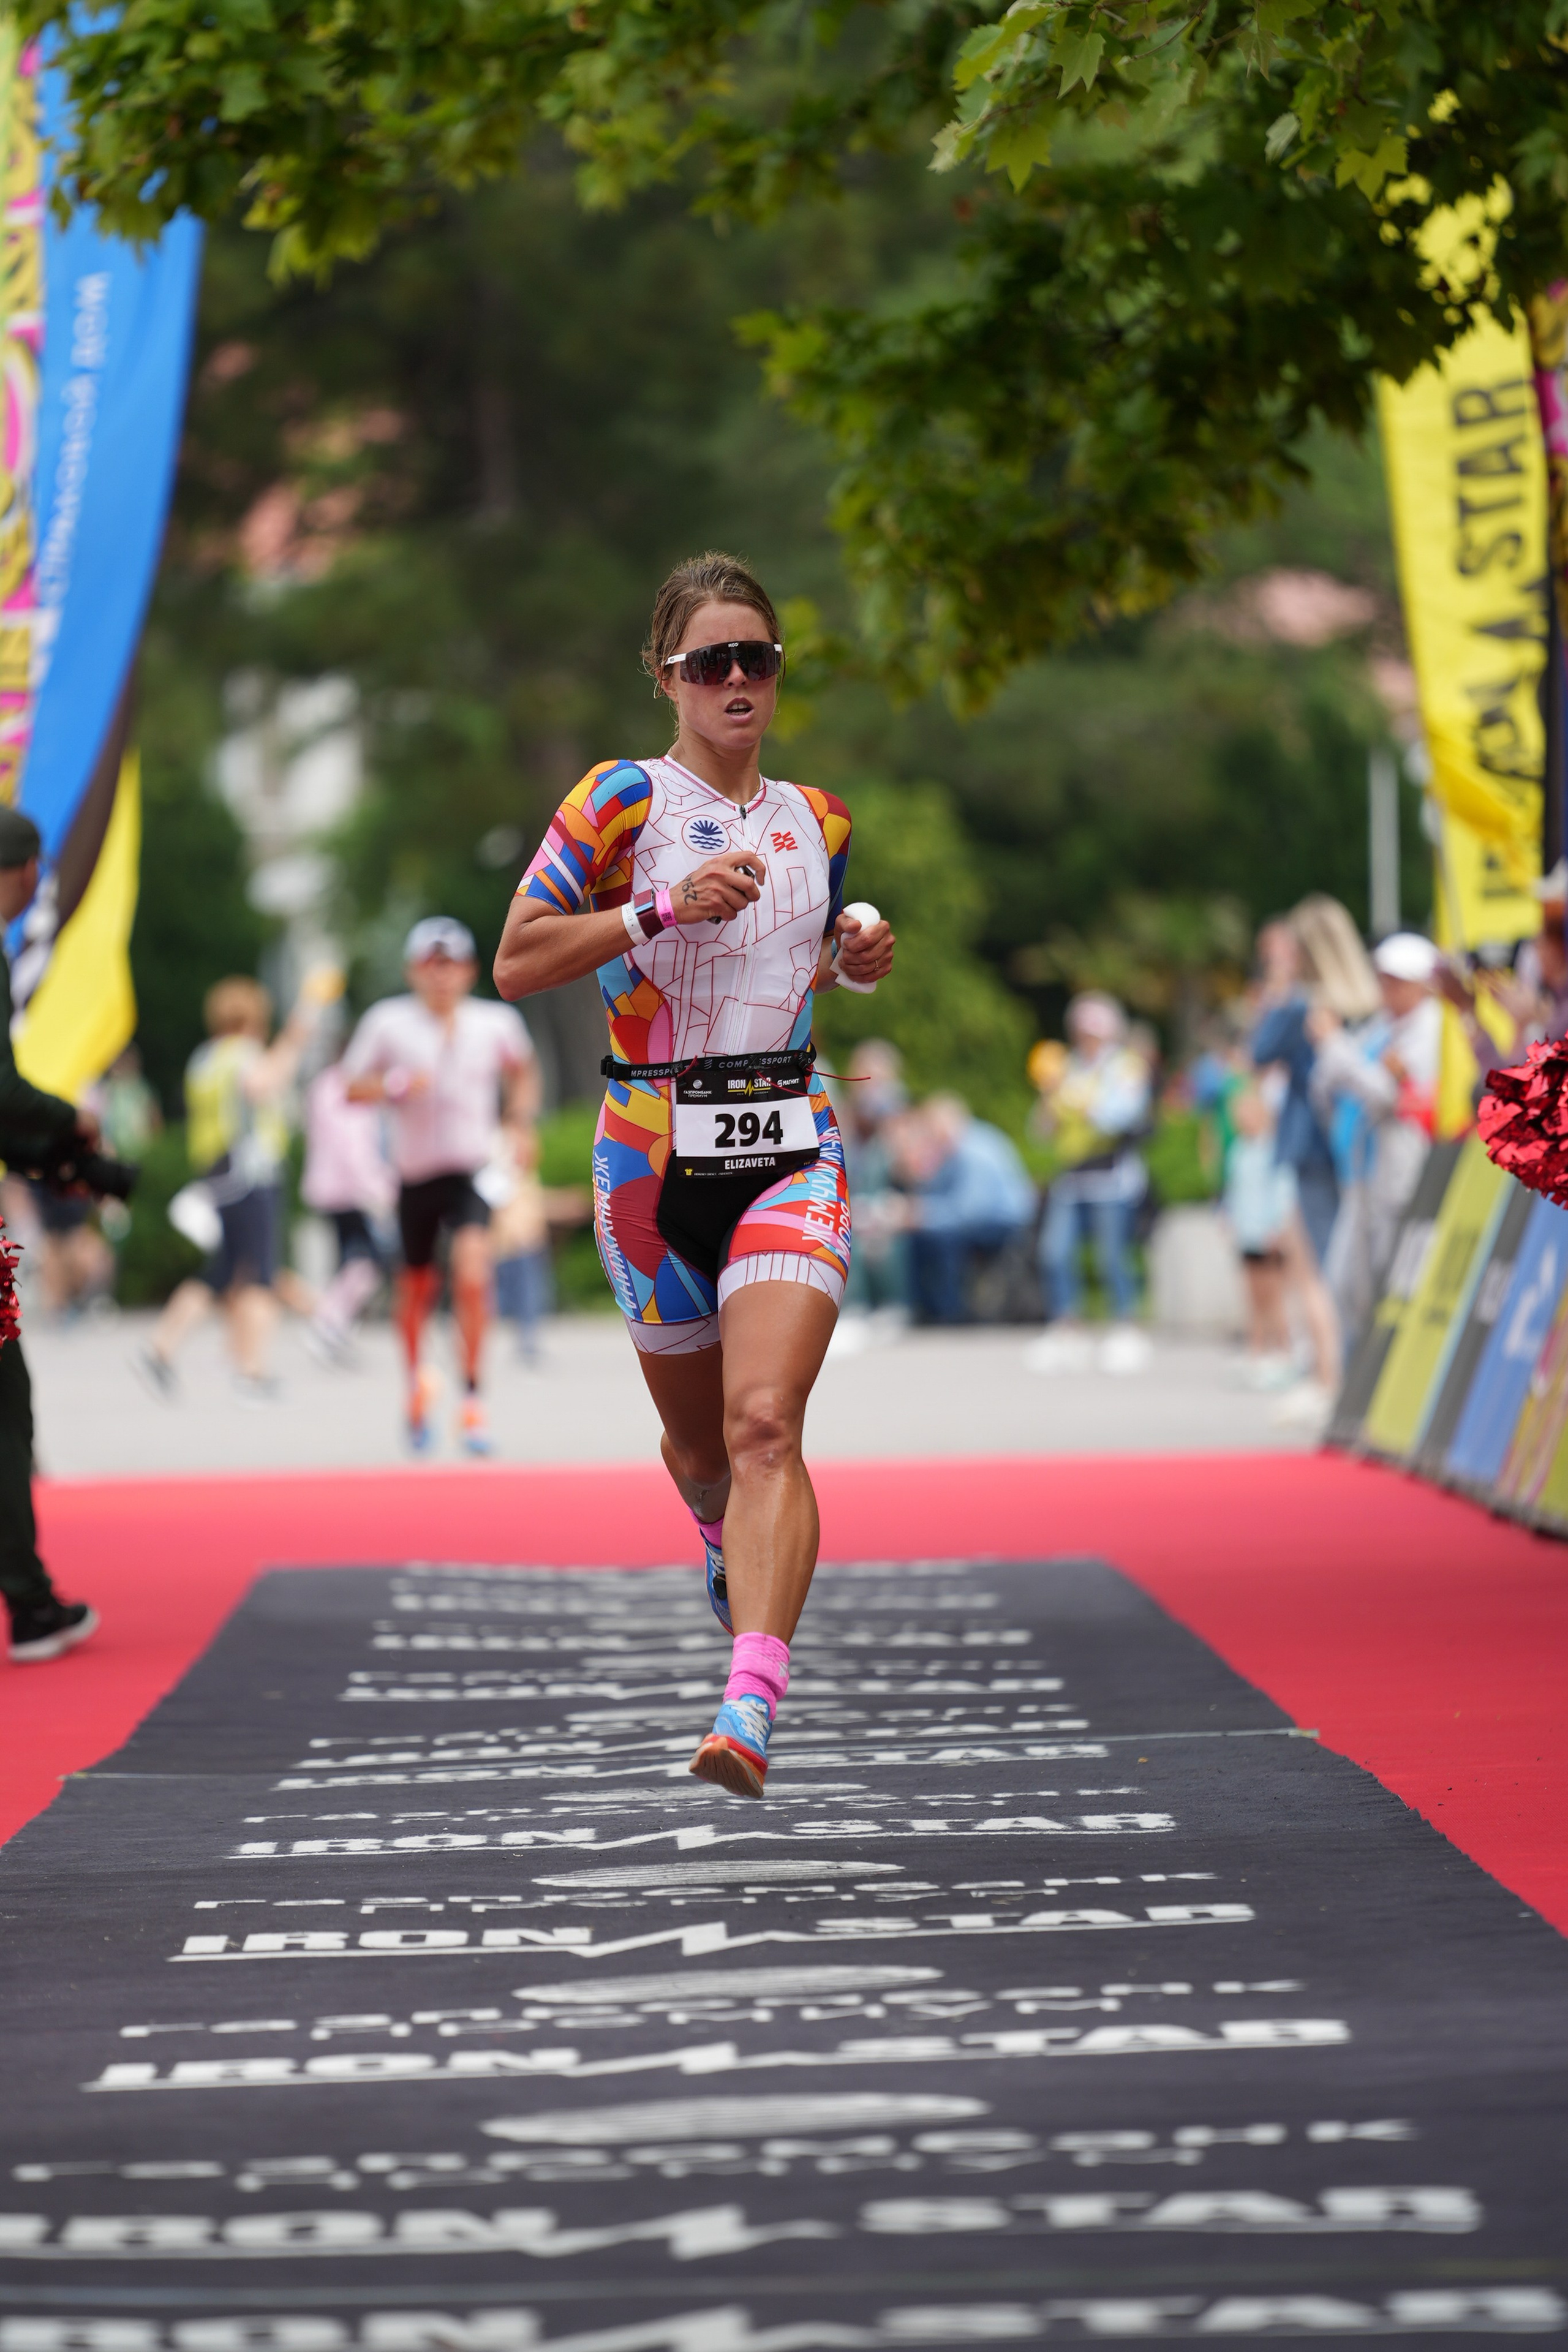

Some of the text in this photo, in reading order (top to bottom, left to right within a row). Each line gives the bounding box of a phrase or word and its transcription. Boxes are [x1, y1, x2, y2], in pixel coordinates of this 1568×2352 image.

[1452, 375, 1528, 577] STAR
[718, 1056, 791, 1068] COMPSSPORT
[728, 1077, 771, 1089] IRON STAR
[714, 1110, 783, 1148] 294
[725, 1157, 775, 1170] ELIZAVETA
[236, 1812, 1175, 1854] IRON STAR
[182, 1903, 1256, 1954] IRON STAR
[99, 2018, 1351, 2084] IRON STAR
[859, 2185, 1481, 2234] STAR
[0, 2286, 1566, 2352] RON STAR
